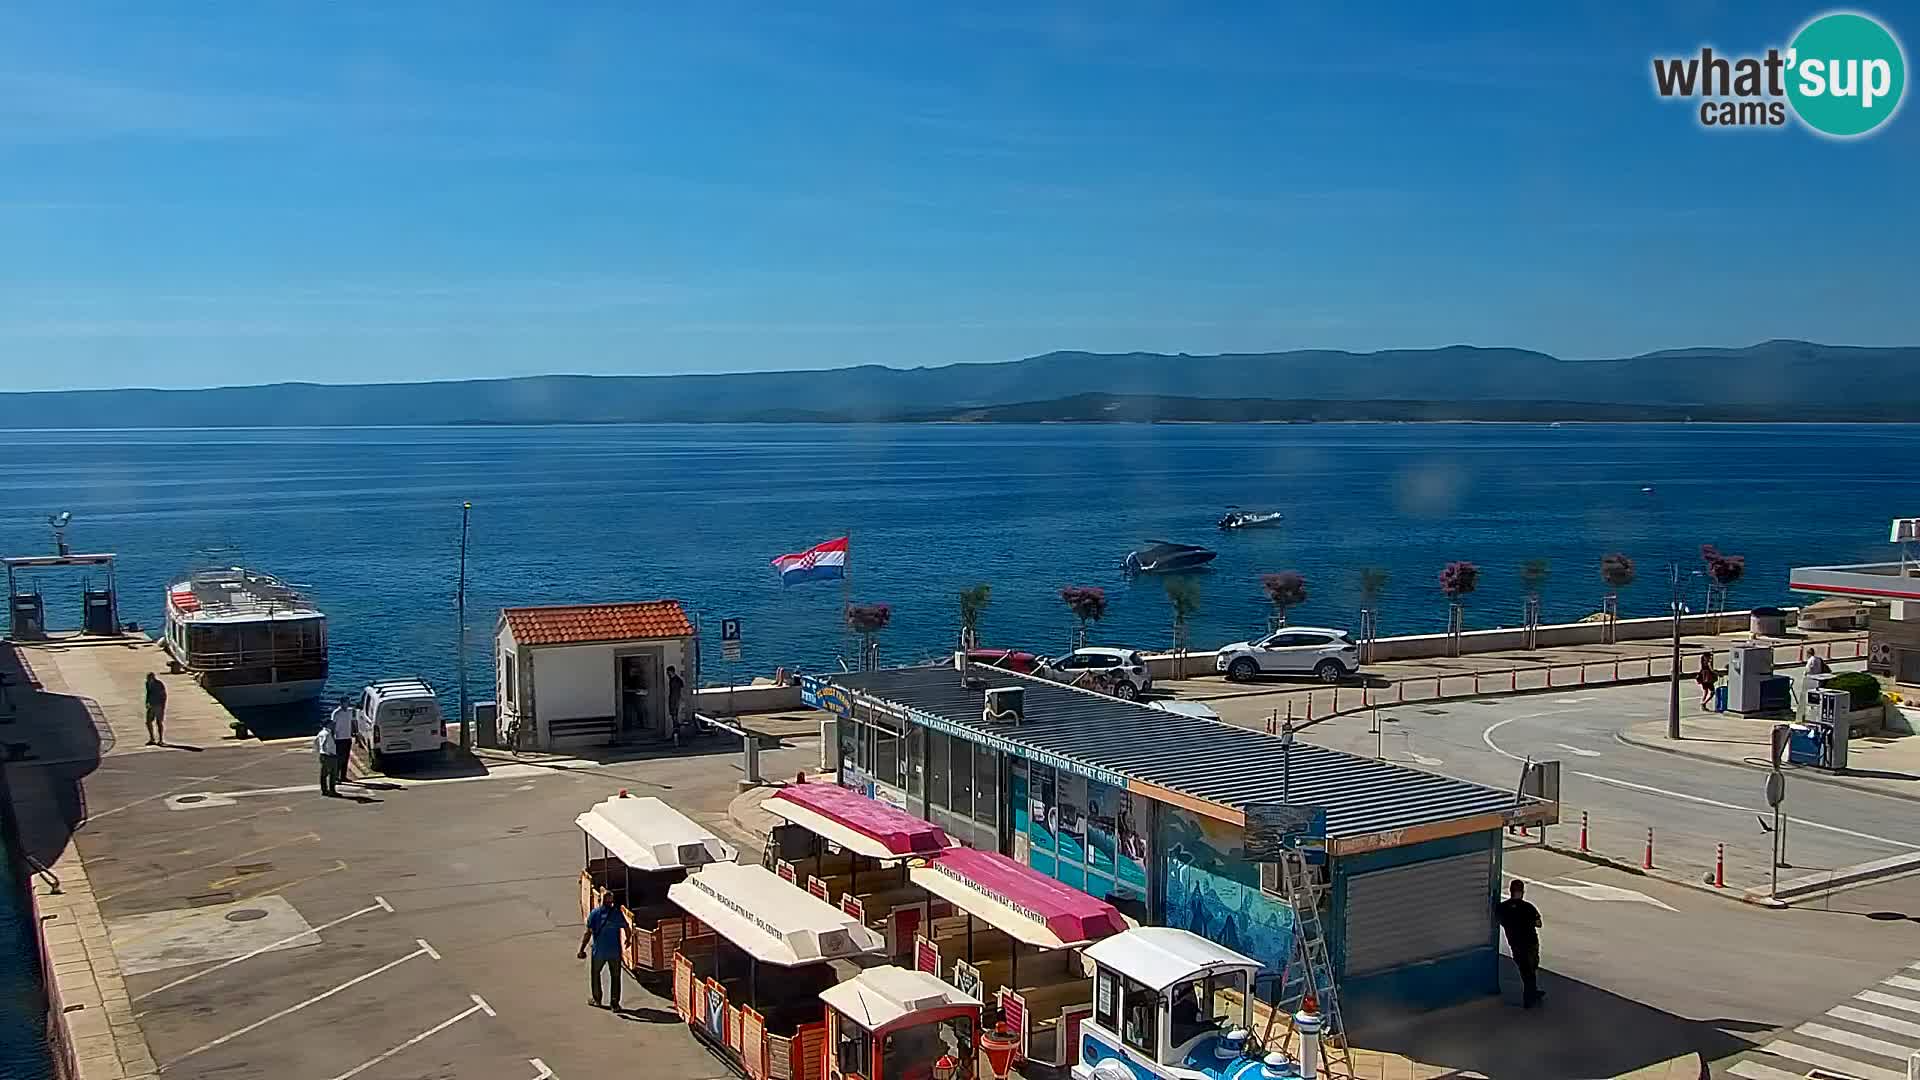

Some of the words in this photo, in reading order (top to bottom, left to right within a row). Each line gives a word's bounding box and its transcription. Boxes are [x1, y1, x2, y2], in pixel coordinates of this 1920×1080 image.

[726, 621, 736, 638] P
[987, 736, 1016, 754] POSTAJA
[1025, 748, 1039, 761] BUS
[1040, 753, 1070, 771] STATION
[1073, 763, 1097, 779] TICKET
[1097, 771, 1123, 787] OFFICE
[934, 862, 944, 875] BOL
[944, 867, 962, 884] CENTER
[964, 878, 981, 893] BEACH
[1012, 902, 1023, 915] BOL
[1023, 908, 1045, 926] CENTER
[756, 917, 766, 930] BOL
[765, 923, 783, 941] CENTER
